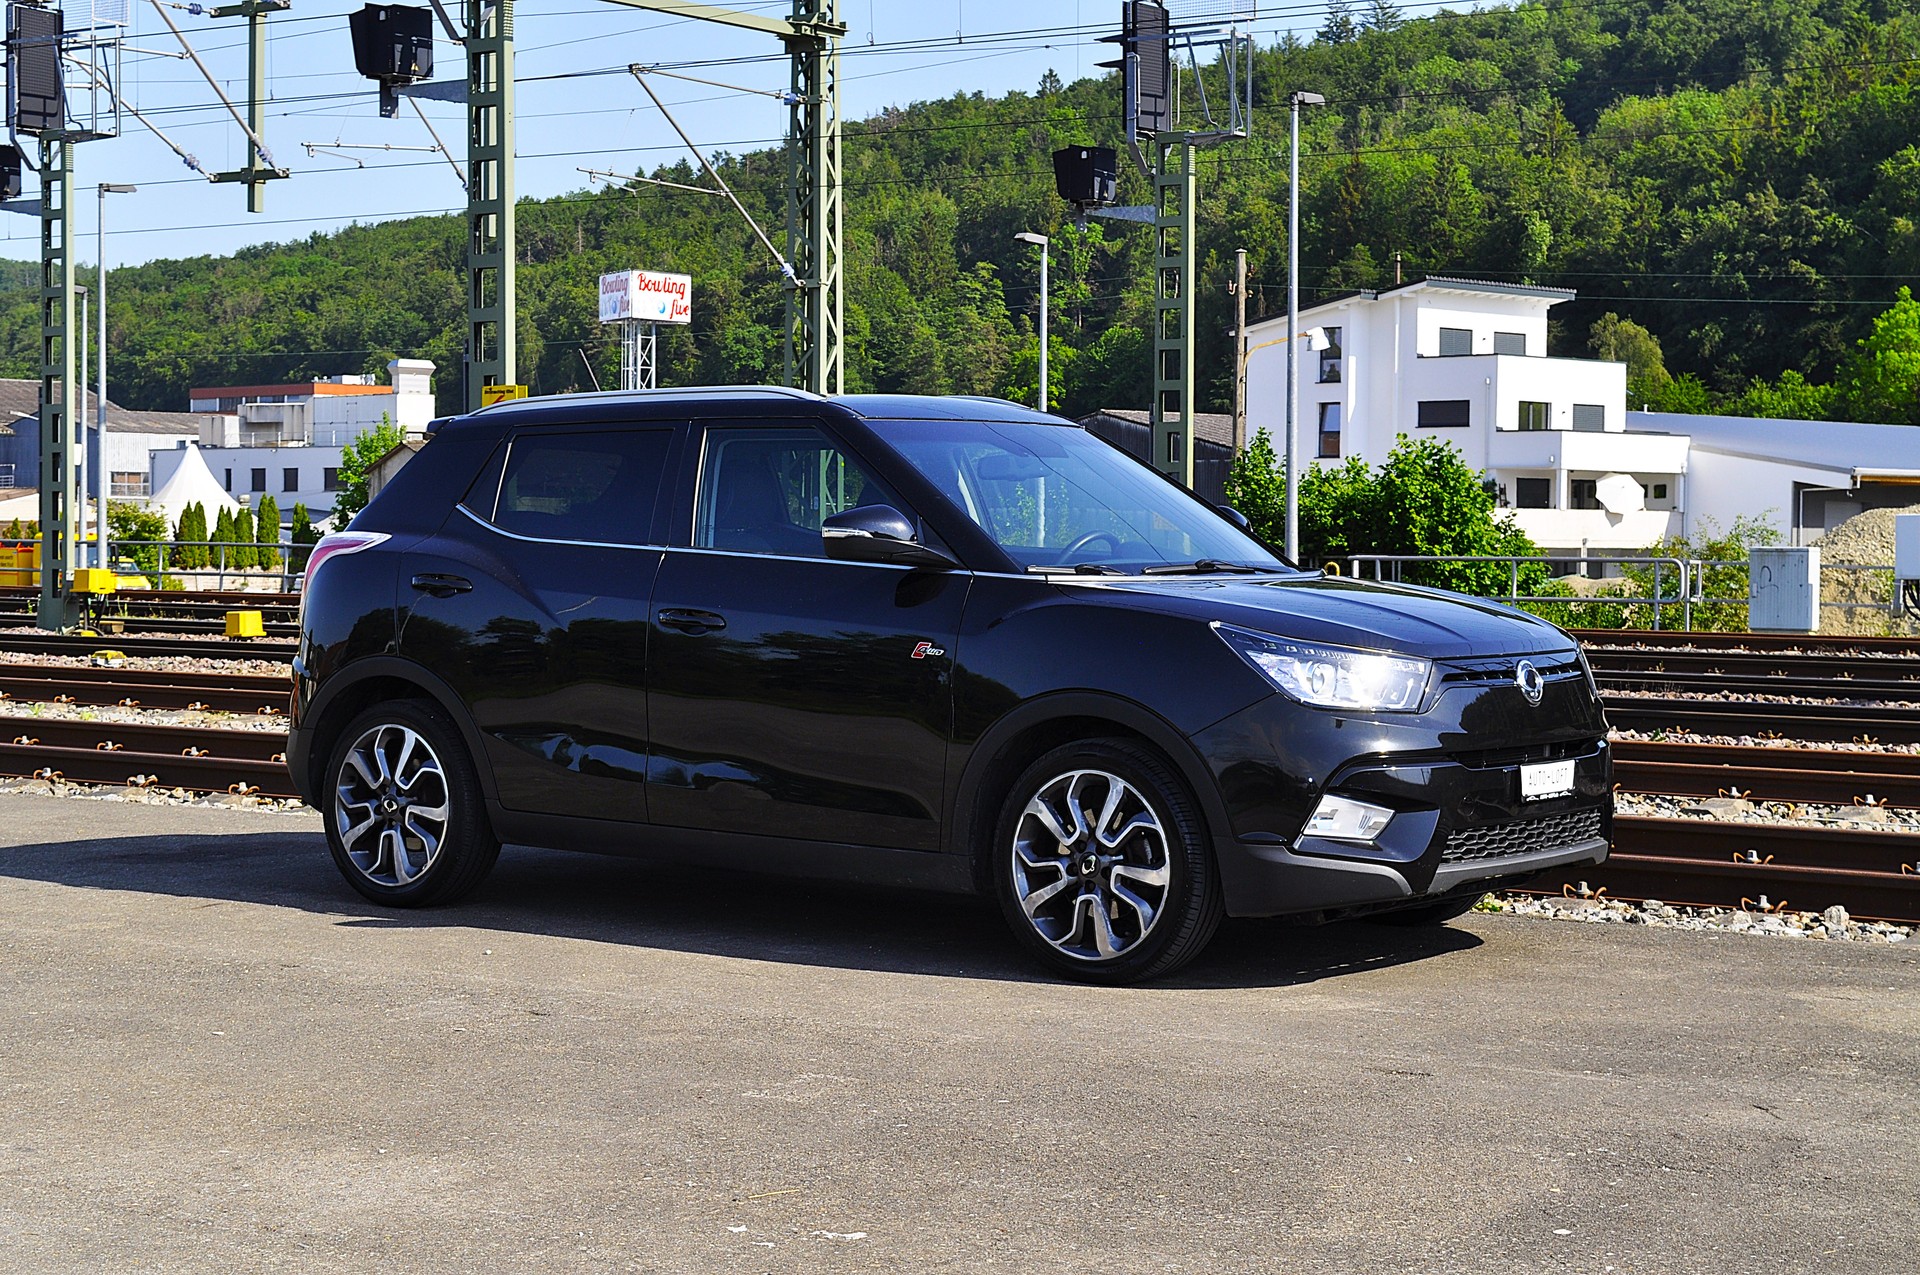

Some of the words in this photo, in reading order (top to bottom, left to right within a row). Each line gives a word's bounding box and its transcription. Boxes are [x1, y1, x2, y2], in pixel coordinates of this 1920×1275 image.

[601, 275, 628, 296] Bowling
[637, 272, 686, 300] Bowling
[669, 298, 690, 319] five
